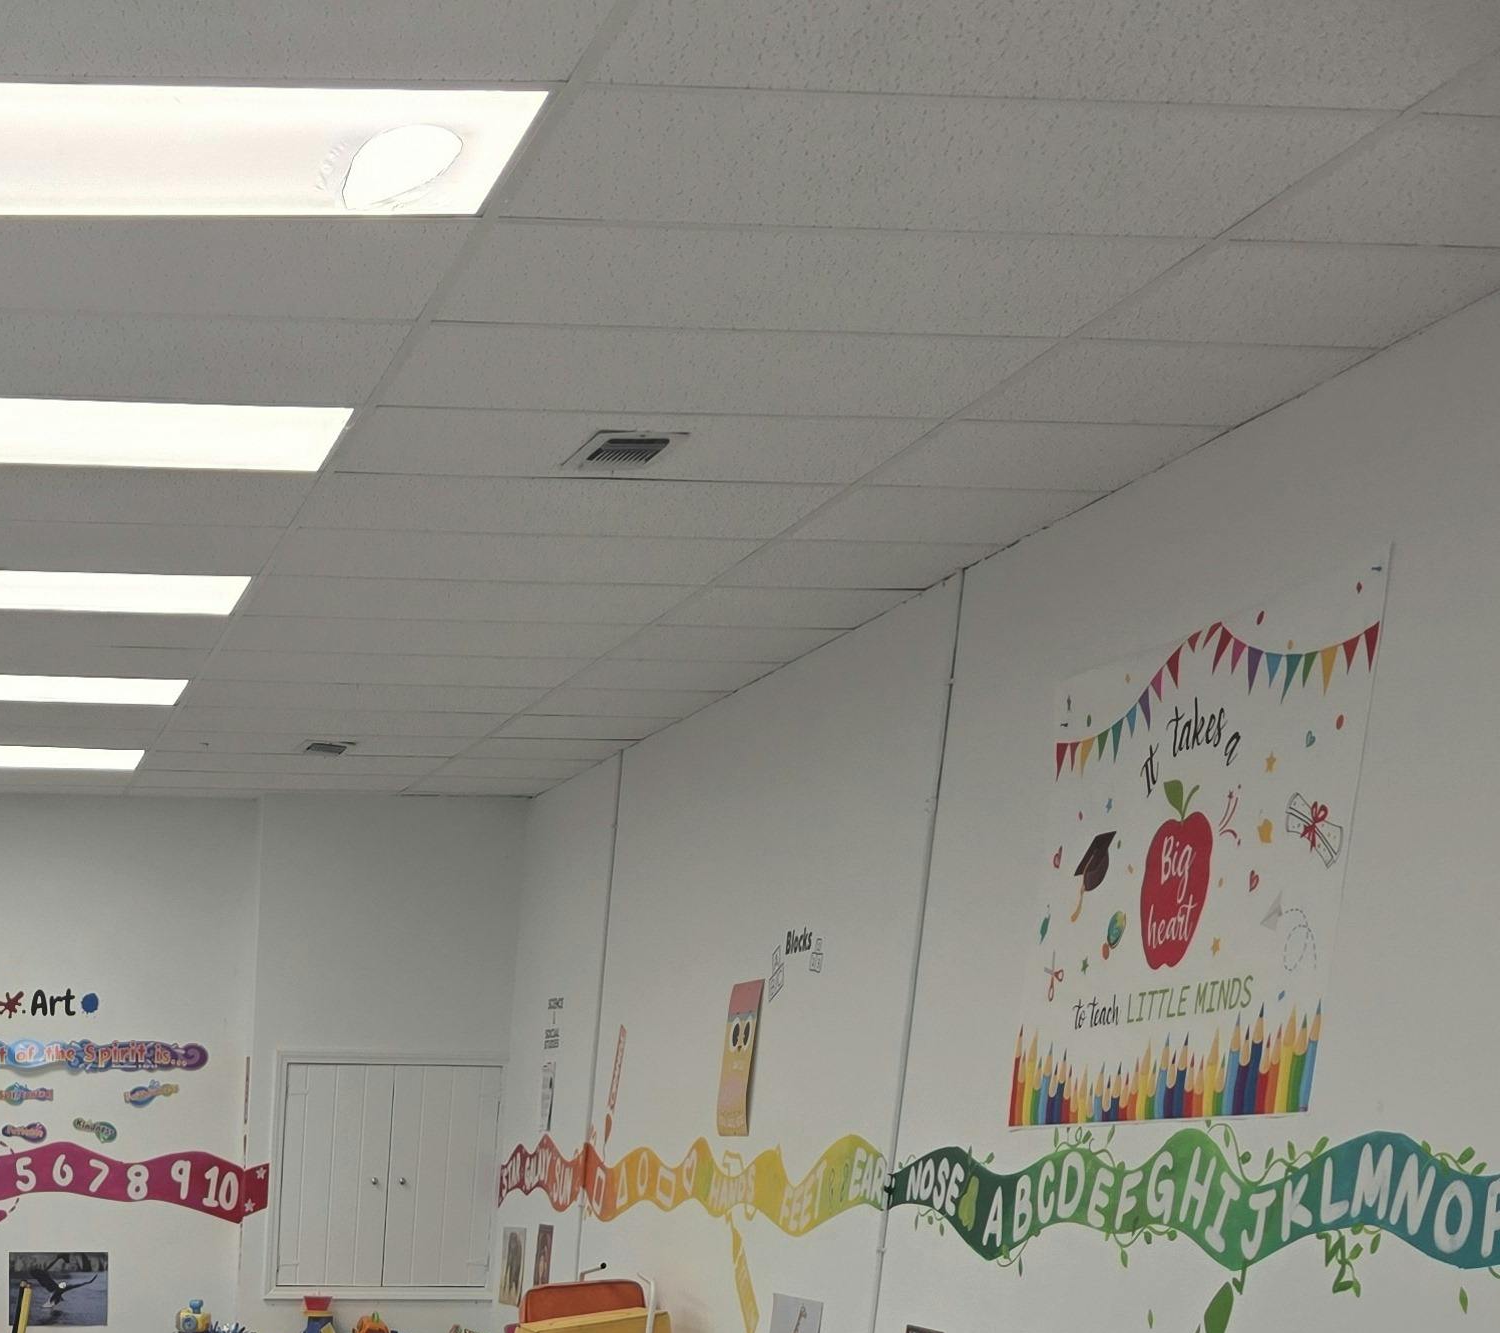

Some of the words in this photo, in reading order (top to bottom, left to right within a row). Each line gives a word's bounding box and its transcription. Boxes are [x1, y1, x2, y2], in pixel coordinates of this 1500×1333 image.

[1166, 696, 1229, 758] takes
[1224, 730, 1242, 768] a
[1160, 834, 1197, 904] Big
[785, 928, 813, 955] Blocks
[1146, 893, 1197, 950] heart
[31, 987, 76, 1016] Art
[1073, 998, 1087, 1031] to
[1089, 993, 1121, 1027] teach
[1126, 983, 1192, 1025] LITTLE
[1194, 973, 1255, 1016] MINDS
[15, 1044, 38, 1063] of
[45, 1043, 77, 1063] the
[84, 1039, 147, 1068] Spirit
[15, 1157, 37, 1192] 5
[52, 1153, 74, 1187] 6
[88, 1159, 110, 1193] 7
[126, 1164, 149, 1200] 8
[170, 1159, 192, 1200] 9
[201, 1165, 240, 1212] 10
[779, 1158, 827, 1232] FEET
[906, 1157, 965, 1217] NOSE
